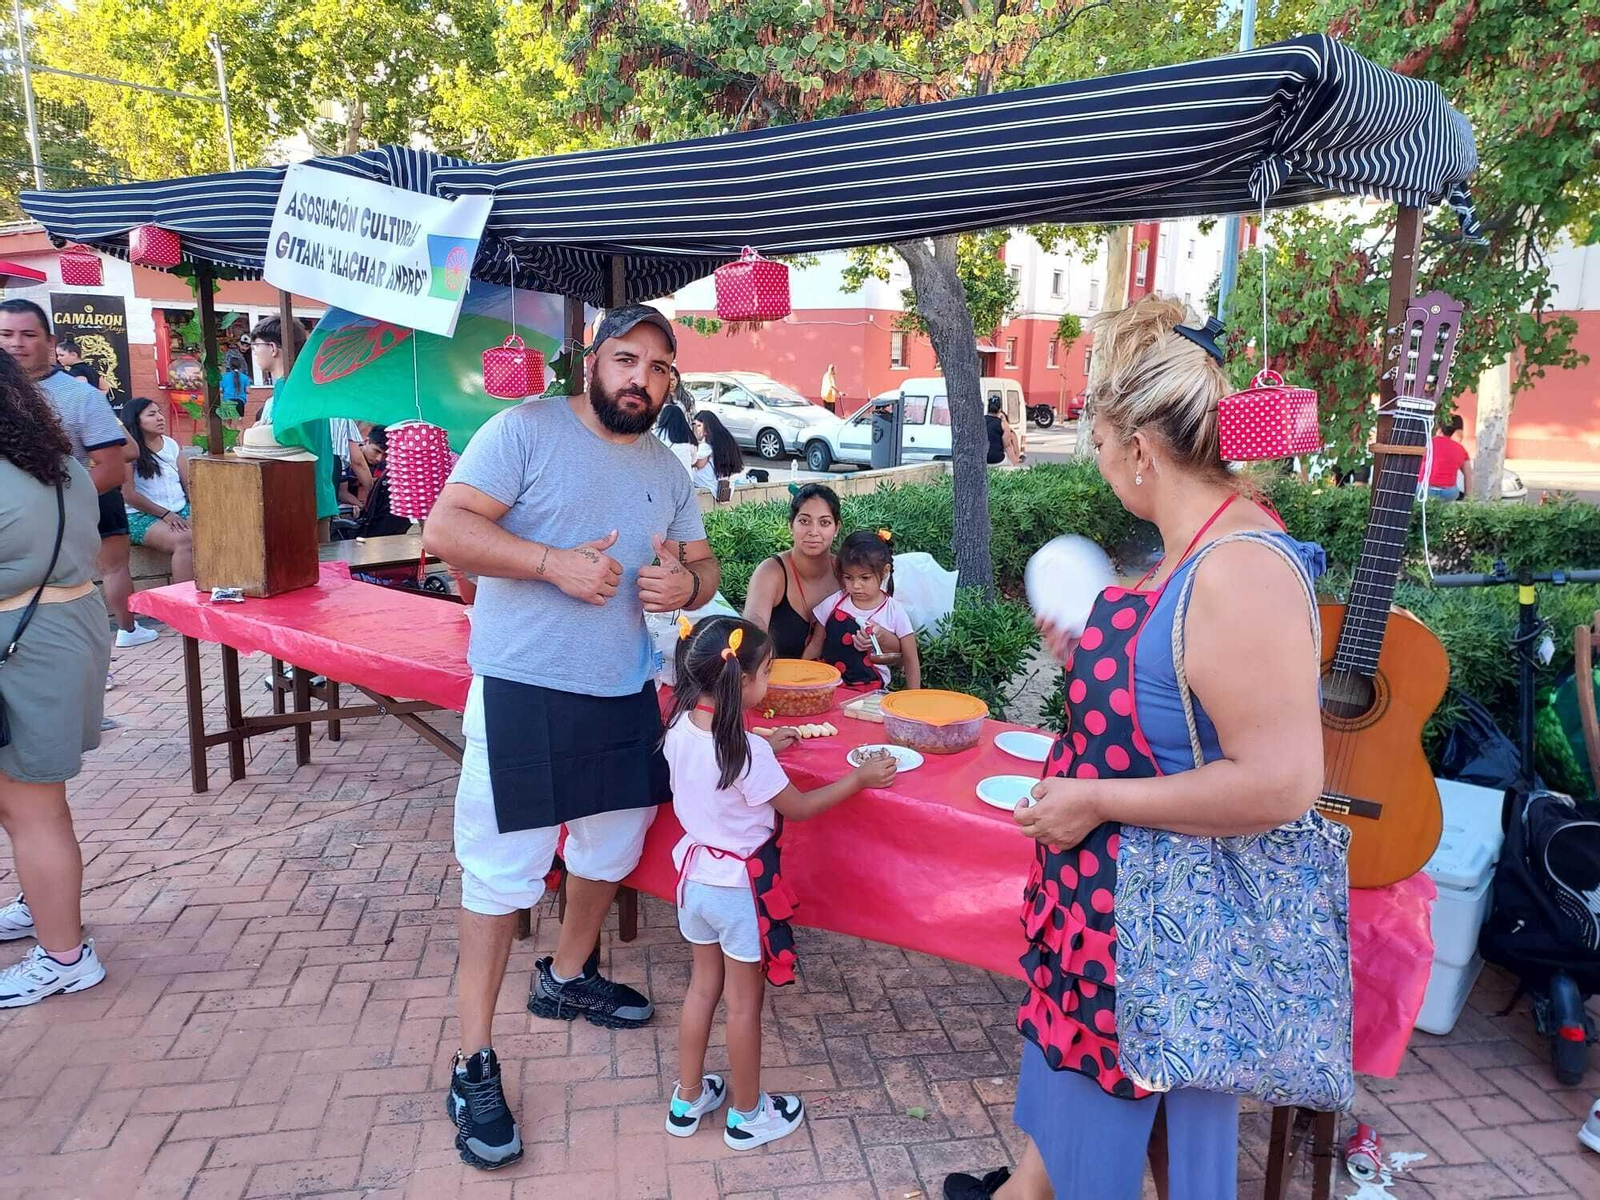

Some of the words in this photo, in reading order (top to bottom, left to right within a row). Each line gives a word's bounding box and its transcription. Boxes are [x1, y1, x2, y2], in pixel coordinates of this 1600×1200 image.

[284, 191, 359, 233] ASOSIACIÓN
[275, 231, 325, 270] GITANA
[328, 246, 387, 288] "ALACHAR
[385, 261, 428, 297] ANDRÓ"
